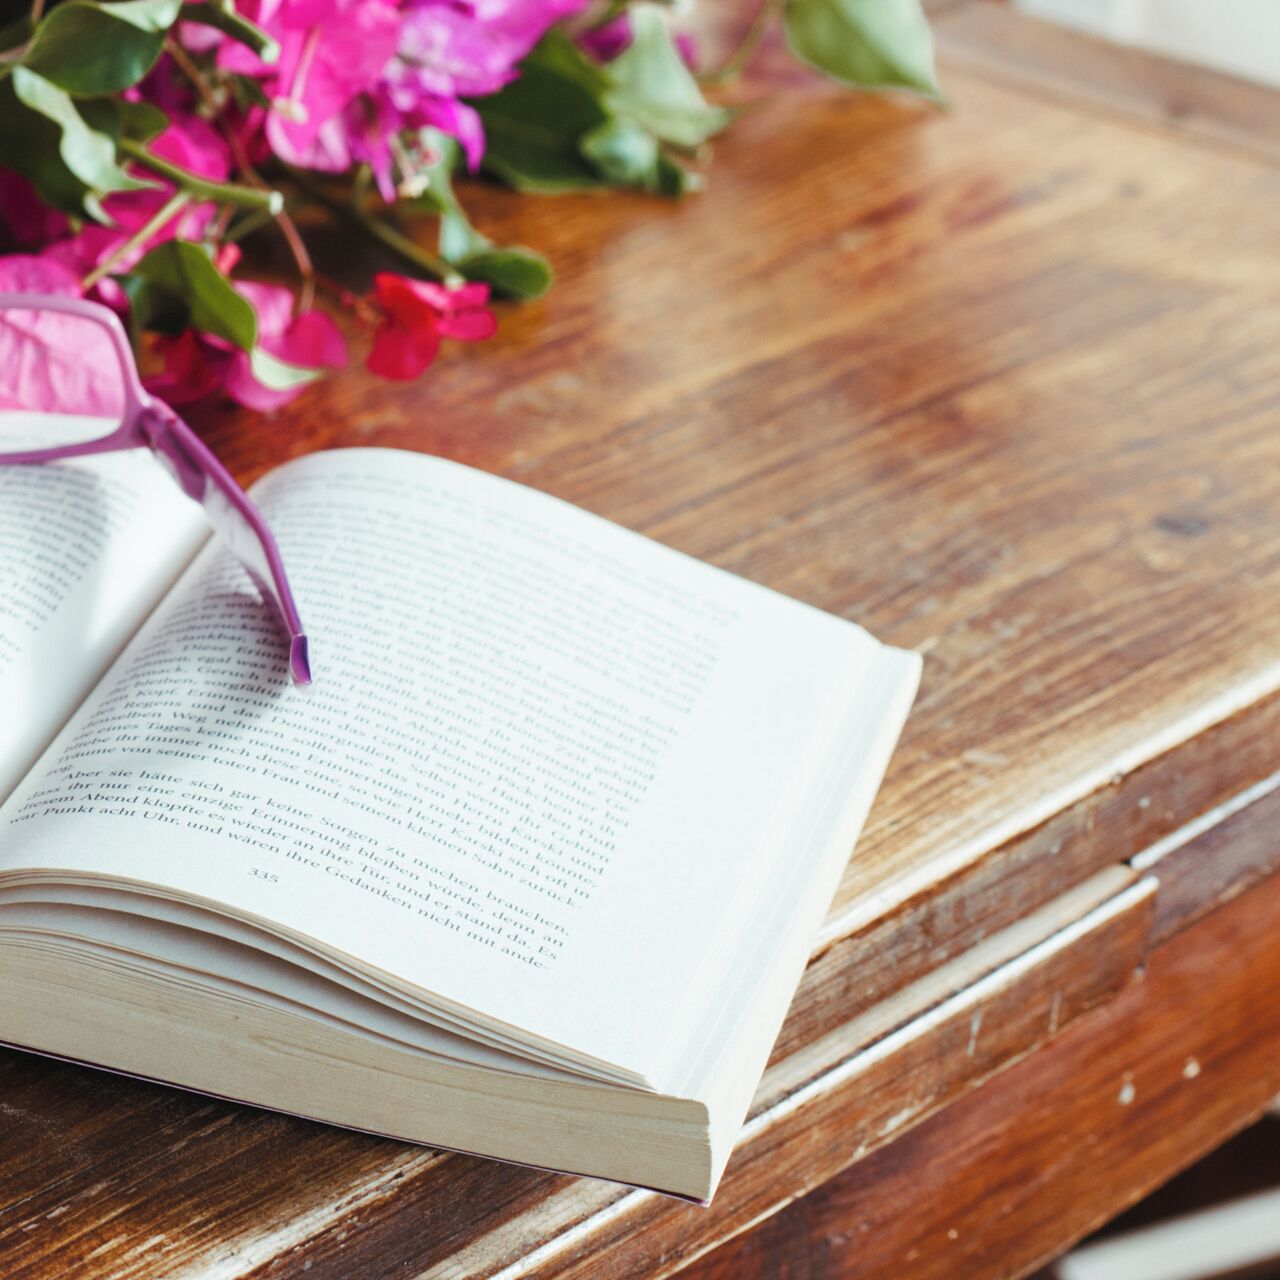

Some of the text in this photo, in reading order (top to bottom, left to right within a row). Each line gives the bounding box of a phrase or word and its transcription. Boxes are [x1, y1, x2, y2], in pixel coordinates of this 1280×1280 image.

[9, 812, 38, 824] war
[41, 804, 95, 816] Punkt
[185, 821, 223, 834] und
[227, 831, 279, 853] wären
[285, 850, 320, 867] ihre
[324, 865, 412, 909] Gedanken
[416, 908, 461, 931] nicht
[466, 930, 496, 947] mit
[81, 792, 139, 803] Abend
[142, 796, 202, 814] klopfte
[230, 817, 289, 840] wieder
[292, 840, 315, 851] an
[318, 848, 354, 864] ihre
[395, 881, 431, 901] und
[456, 910, 503, 935] stand
[537, 945, 558, 960] Es
[138, 769, 183, 782] hätte
[189, 780, 224, 792] sich
[229, 789, 259, 801] gar
[266, 797, 313, 817] keine
[318, 816, 379, 846] Sorgen
[384, 846, 406, 858] zu
[412, 857, 479, 893] machen
[156, 748, 209, 761] seiner
[212, 756, 257, 773] toten
[261, 767, 300, 785] Frau
[303, 782, 340, 799] und
[342, 797, 403, 825] seinem
[406, 821, 468, 855] kleinen
[471, 852, 514, 878] Sohn
[180, 792, 244, 810] einzige
[246, 807, 351, 851] Erinnerung
[357, 846, 420, 880] bleiben
[491, 911, 535, 934] denn
[541, 936, 564, 947] an
[248, 868, 280, 884] 335
